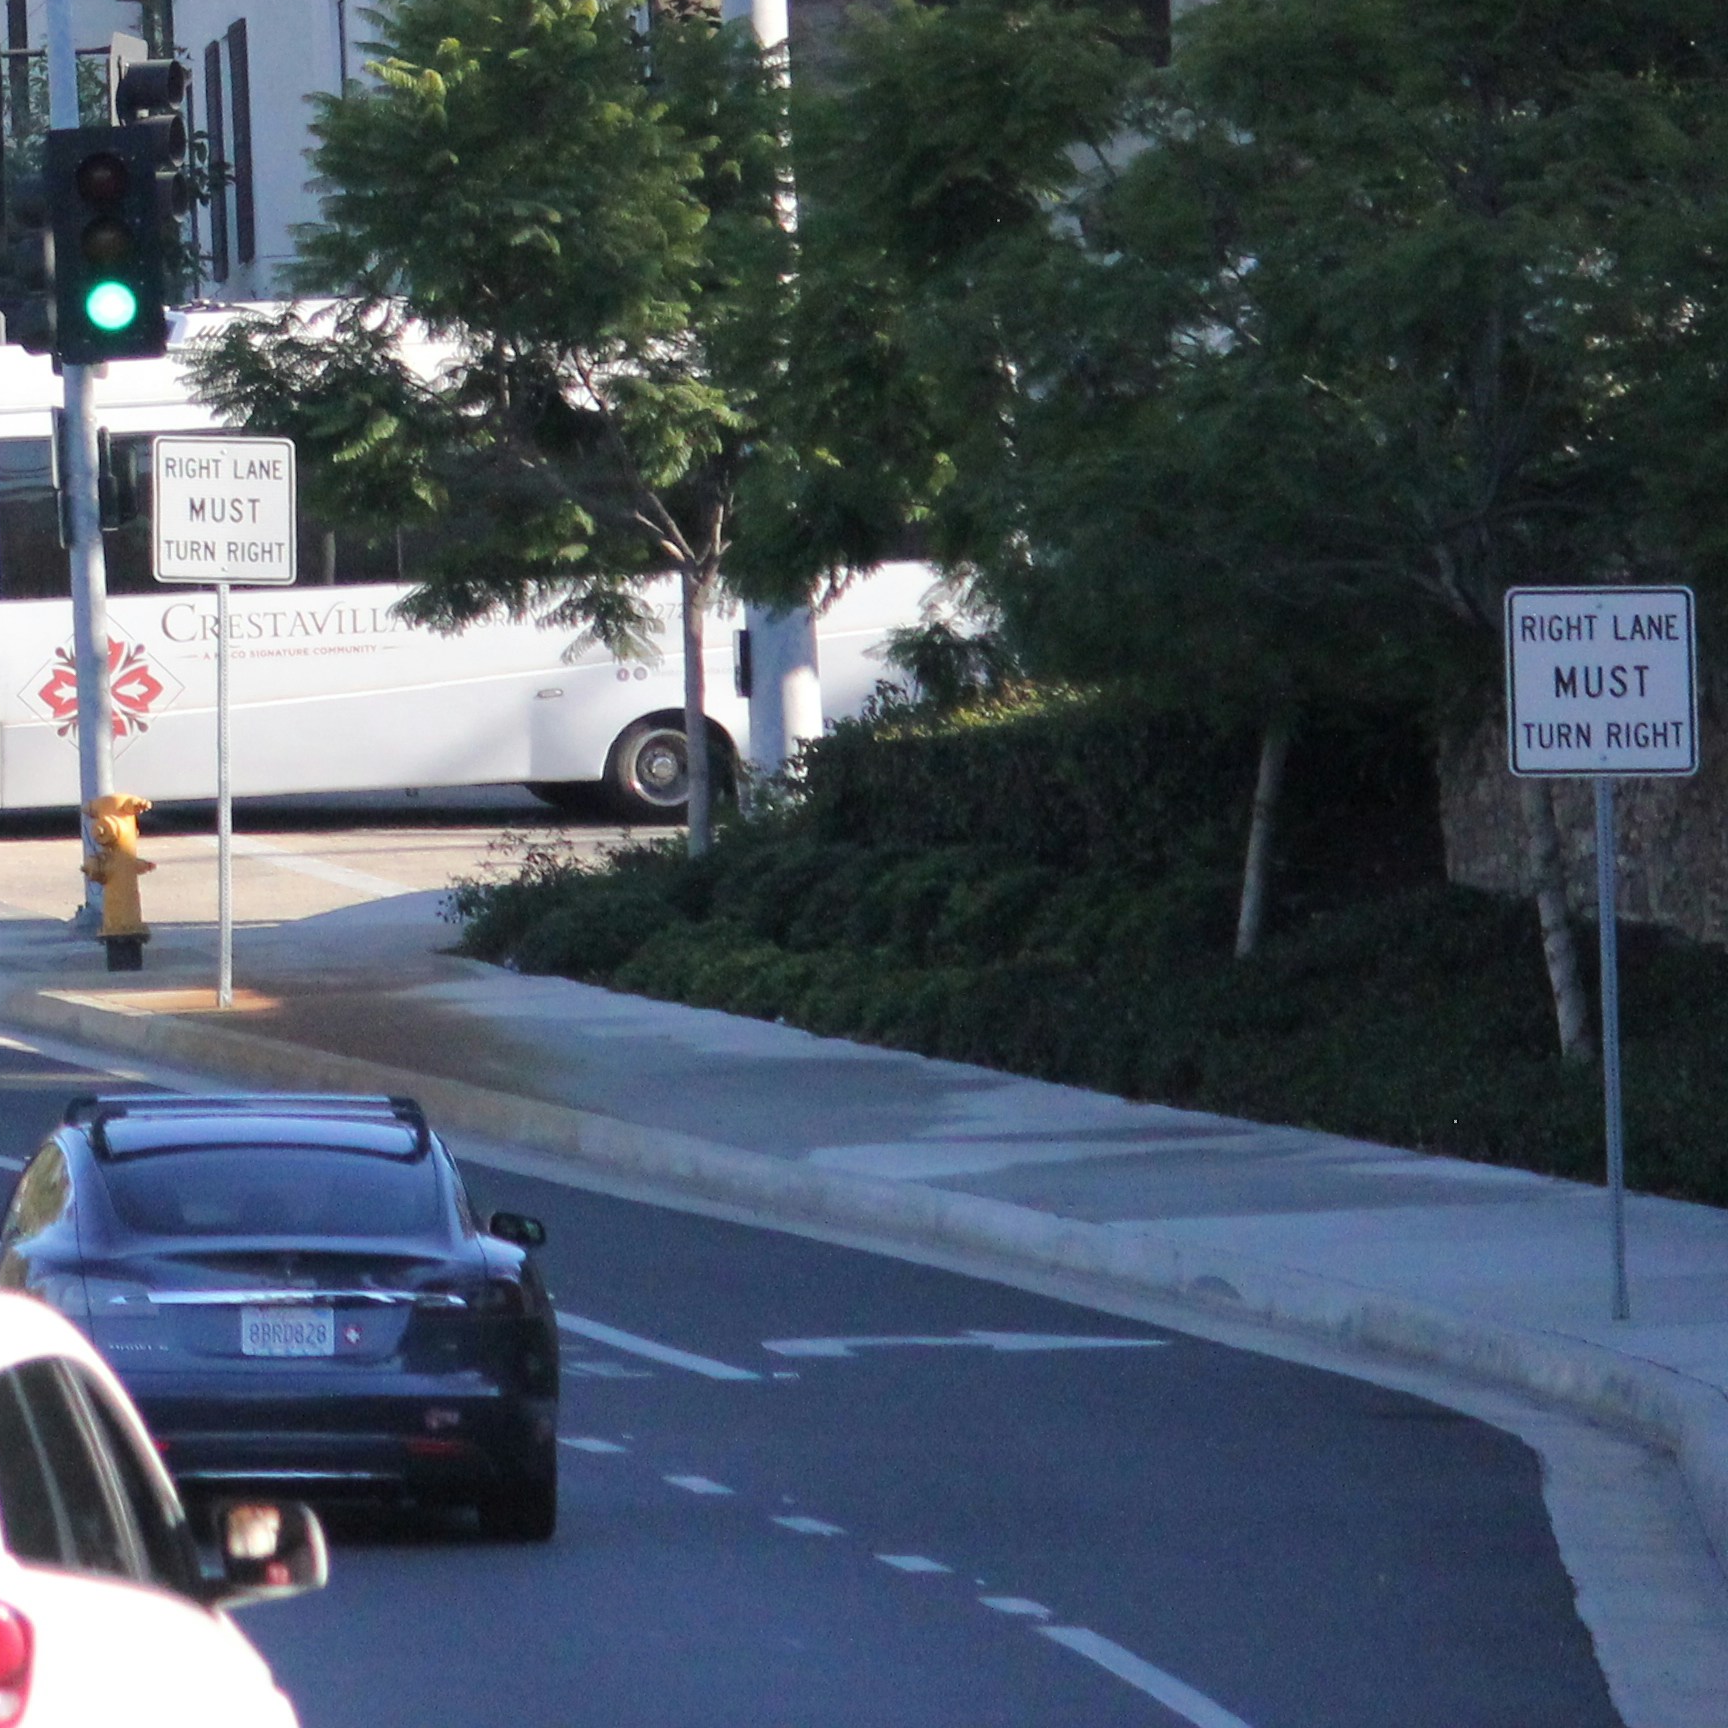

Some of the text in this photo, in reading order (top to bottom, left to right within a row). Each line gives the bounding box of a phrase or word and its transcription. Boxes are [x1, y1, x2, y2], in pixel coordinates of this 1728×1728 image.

[165, 457, 283, 480] RIGHT LANE
[189, 497, 260, 523] MUST
[164, 540, 284, 563] TURN RIGHT
[1522, 614, 1679, 642] RIGHT LANE
[250, 647, 309, 658] SIGNATURE
[313, 643, 377, 655] COMMUNITY
[1554, 665, 1649, 698] MUST
[1523, 722, 1683, 749] TURN RIGHT
